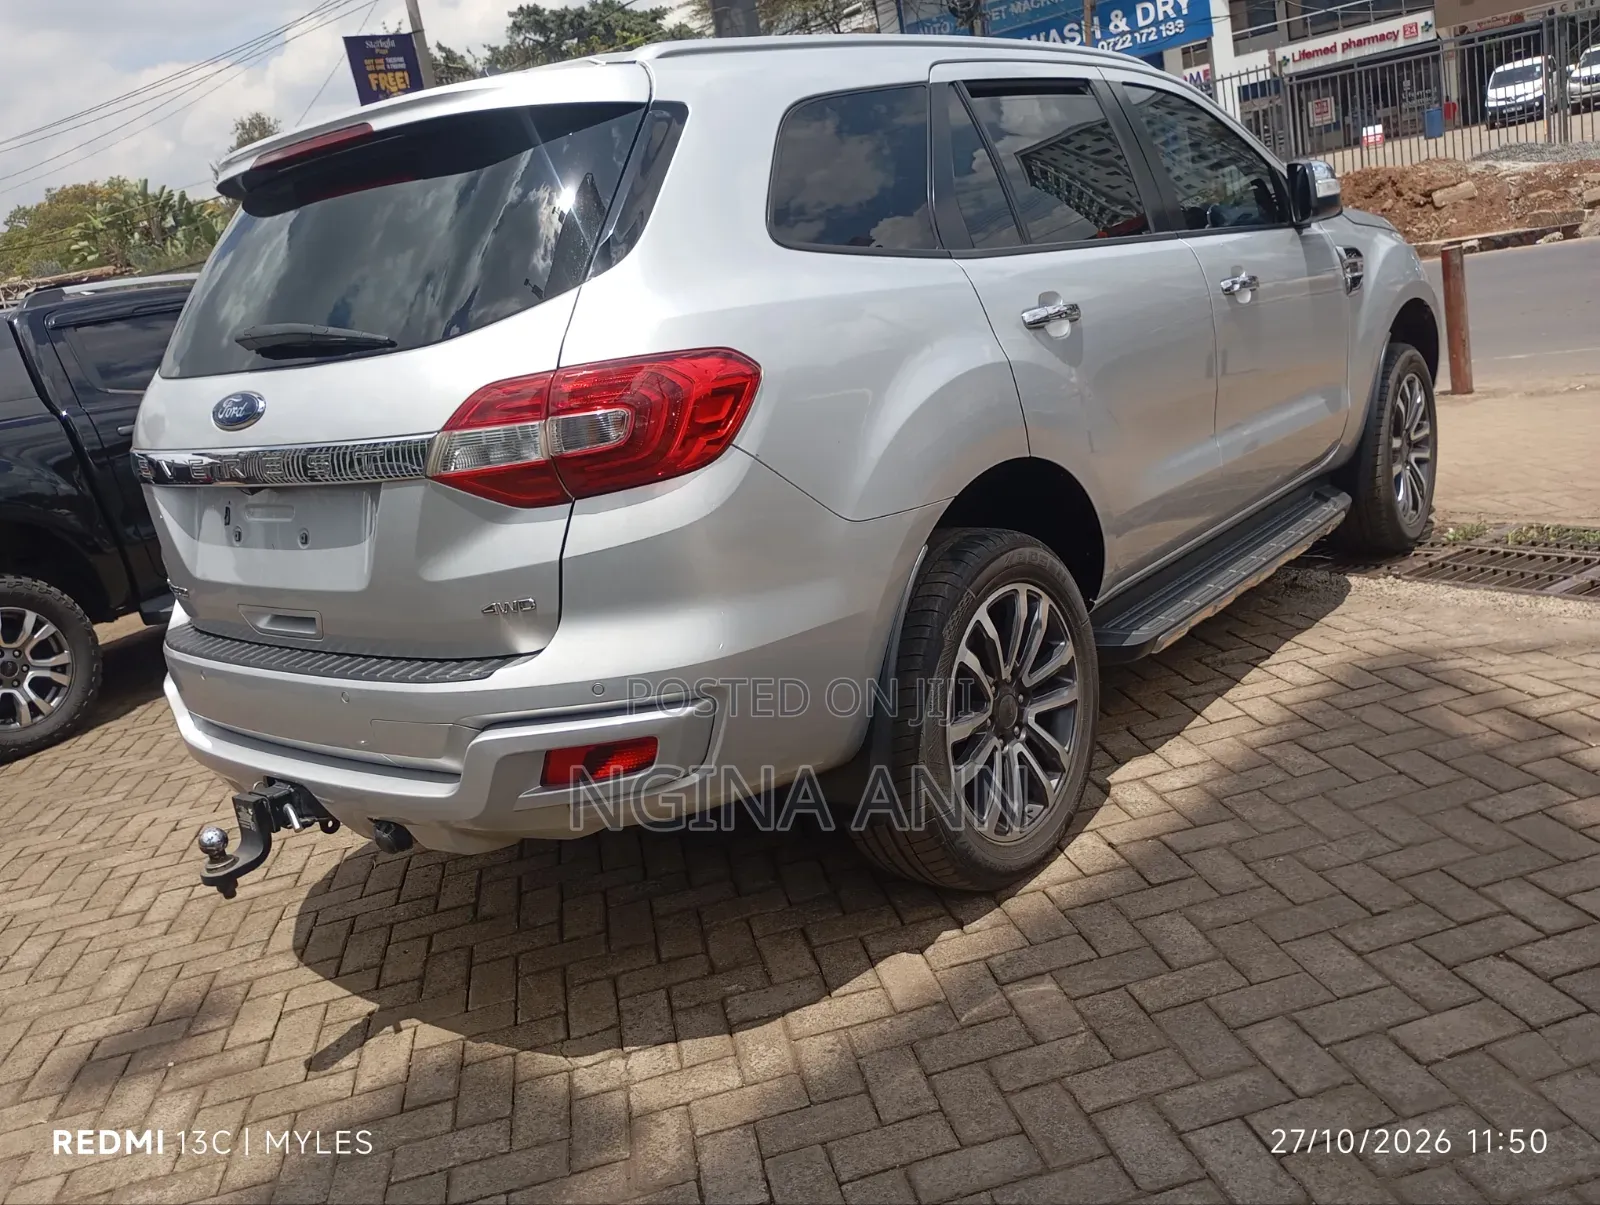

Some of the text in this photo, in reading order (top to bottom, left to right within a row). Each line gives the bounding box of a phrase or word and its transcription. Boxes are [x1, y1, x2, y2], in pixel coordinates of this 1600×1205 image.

[1108, 9, 1131, 35] &
[1136, 0, 1189, 27] DRY
[1135, 26, 1158, 44] 172
[1292, 42, 1337, 63] Lifemed
[1341, 29, 1399, 53] pharmacy
[368, 71, 410, 92] FREE!
[217, 396, 248, 419] Ford
[137, 449, 386, 478] EVEREST
[481, 596, 537, 615] 4WD
